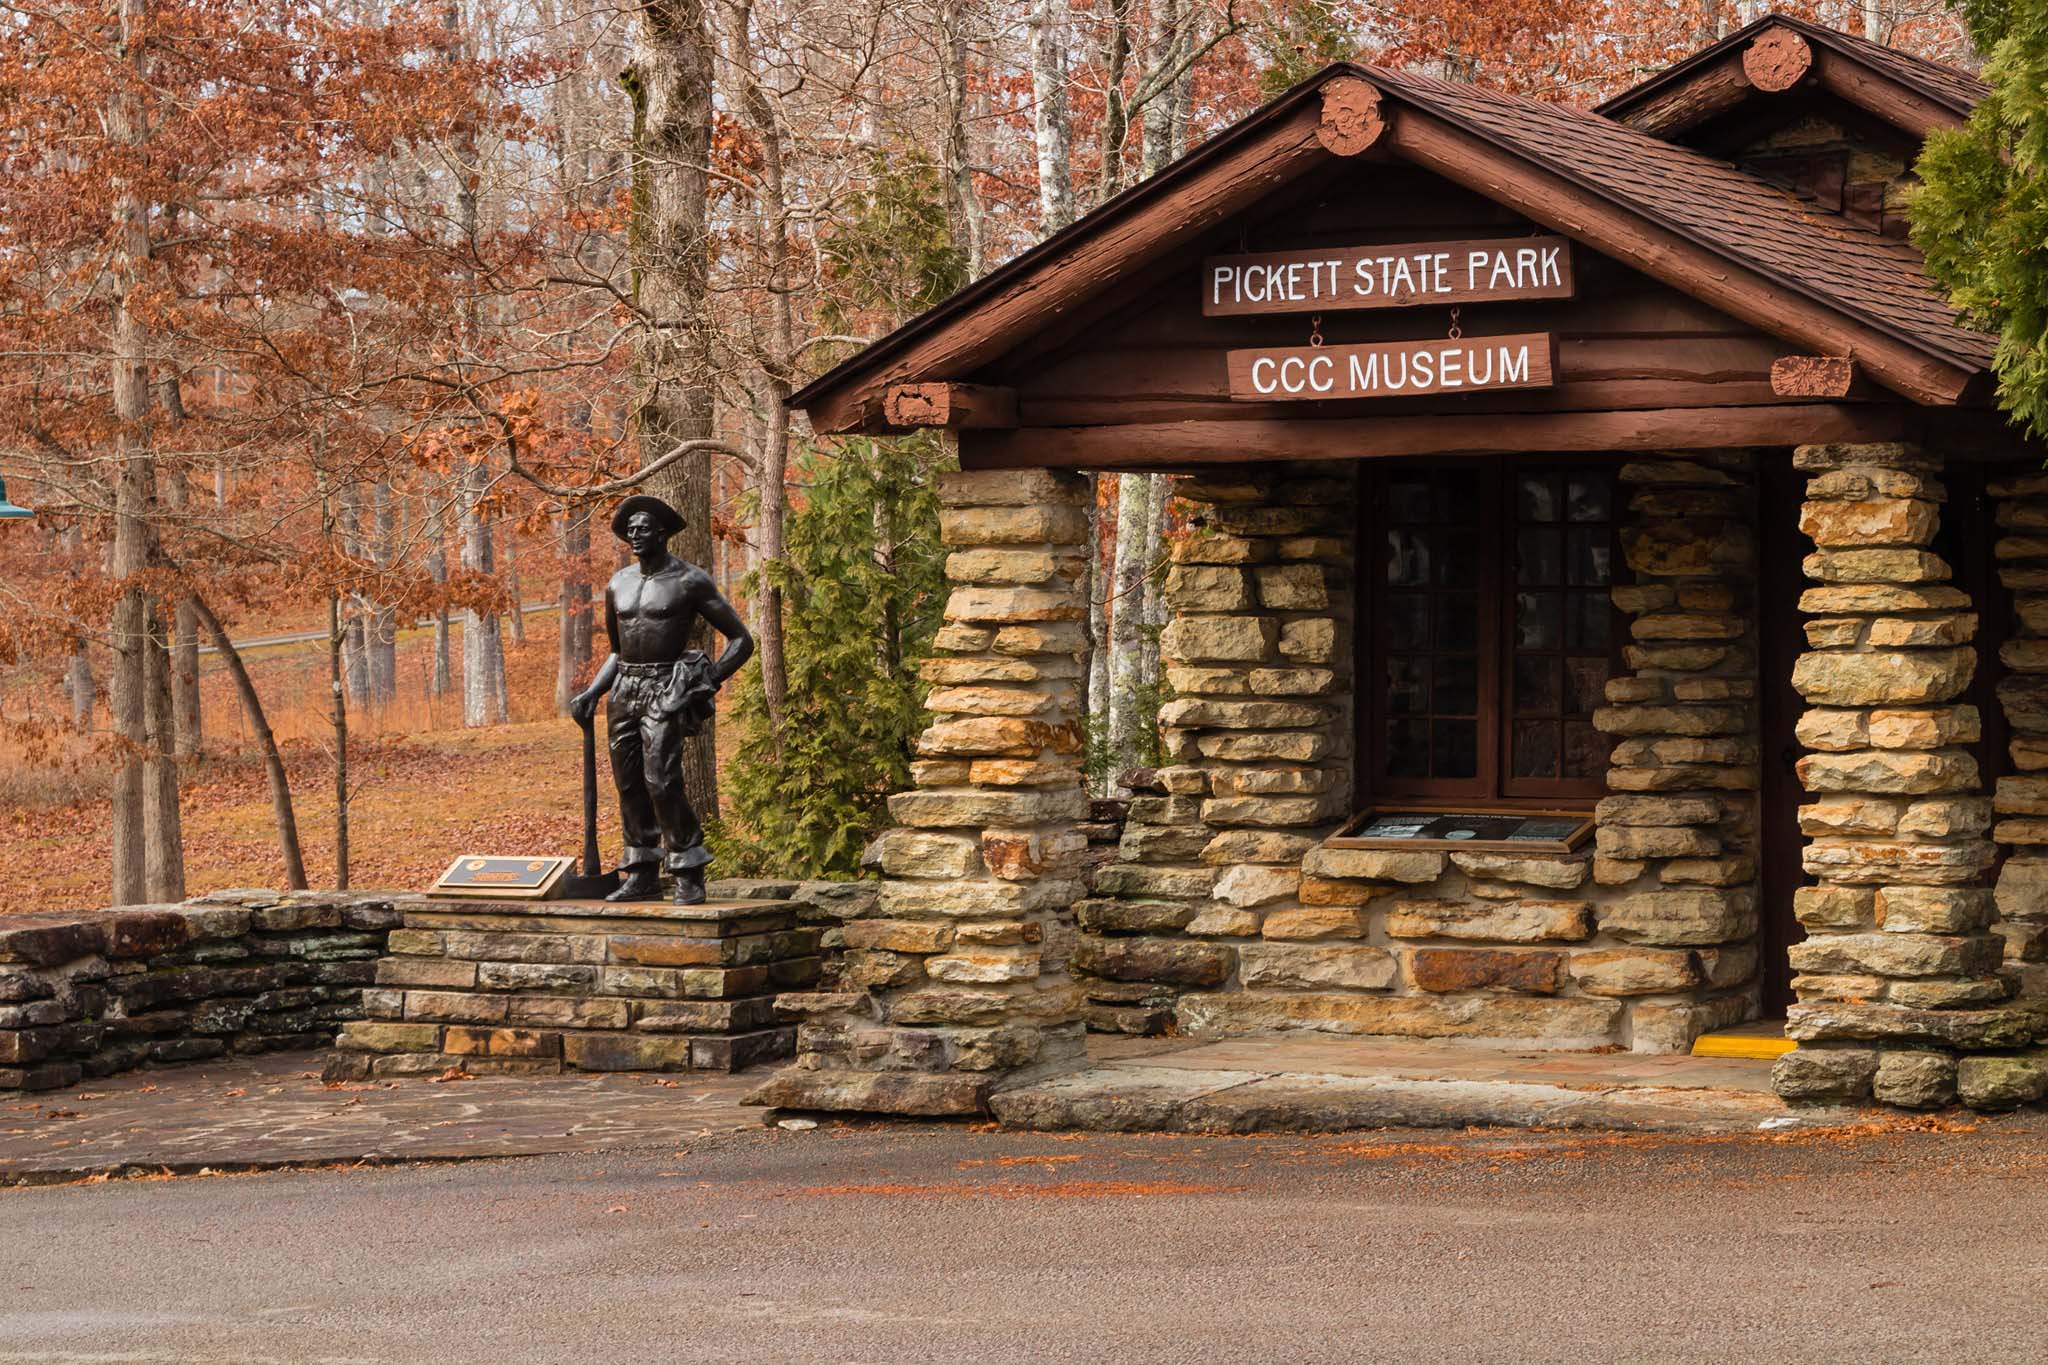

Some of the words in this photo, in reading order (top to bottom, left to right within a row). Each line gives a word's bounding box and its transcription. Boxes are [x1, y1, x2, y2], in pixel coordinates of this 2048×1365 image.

[1213, 259, 1342, 304] PICKETT
[1353, 252, 1452, 297] STATE
[1467, 246, 1562, 290] PARK
[1251, 355, 1334, 393] CCC
[1348, 345, 1529, 391] MUSEUM
